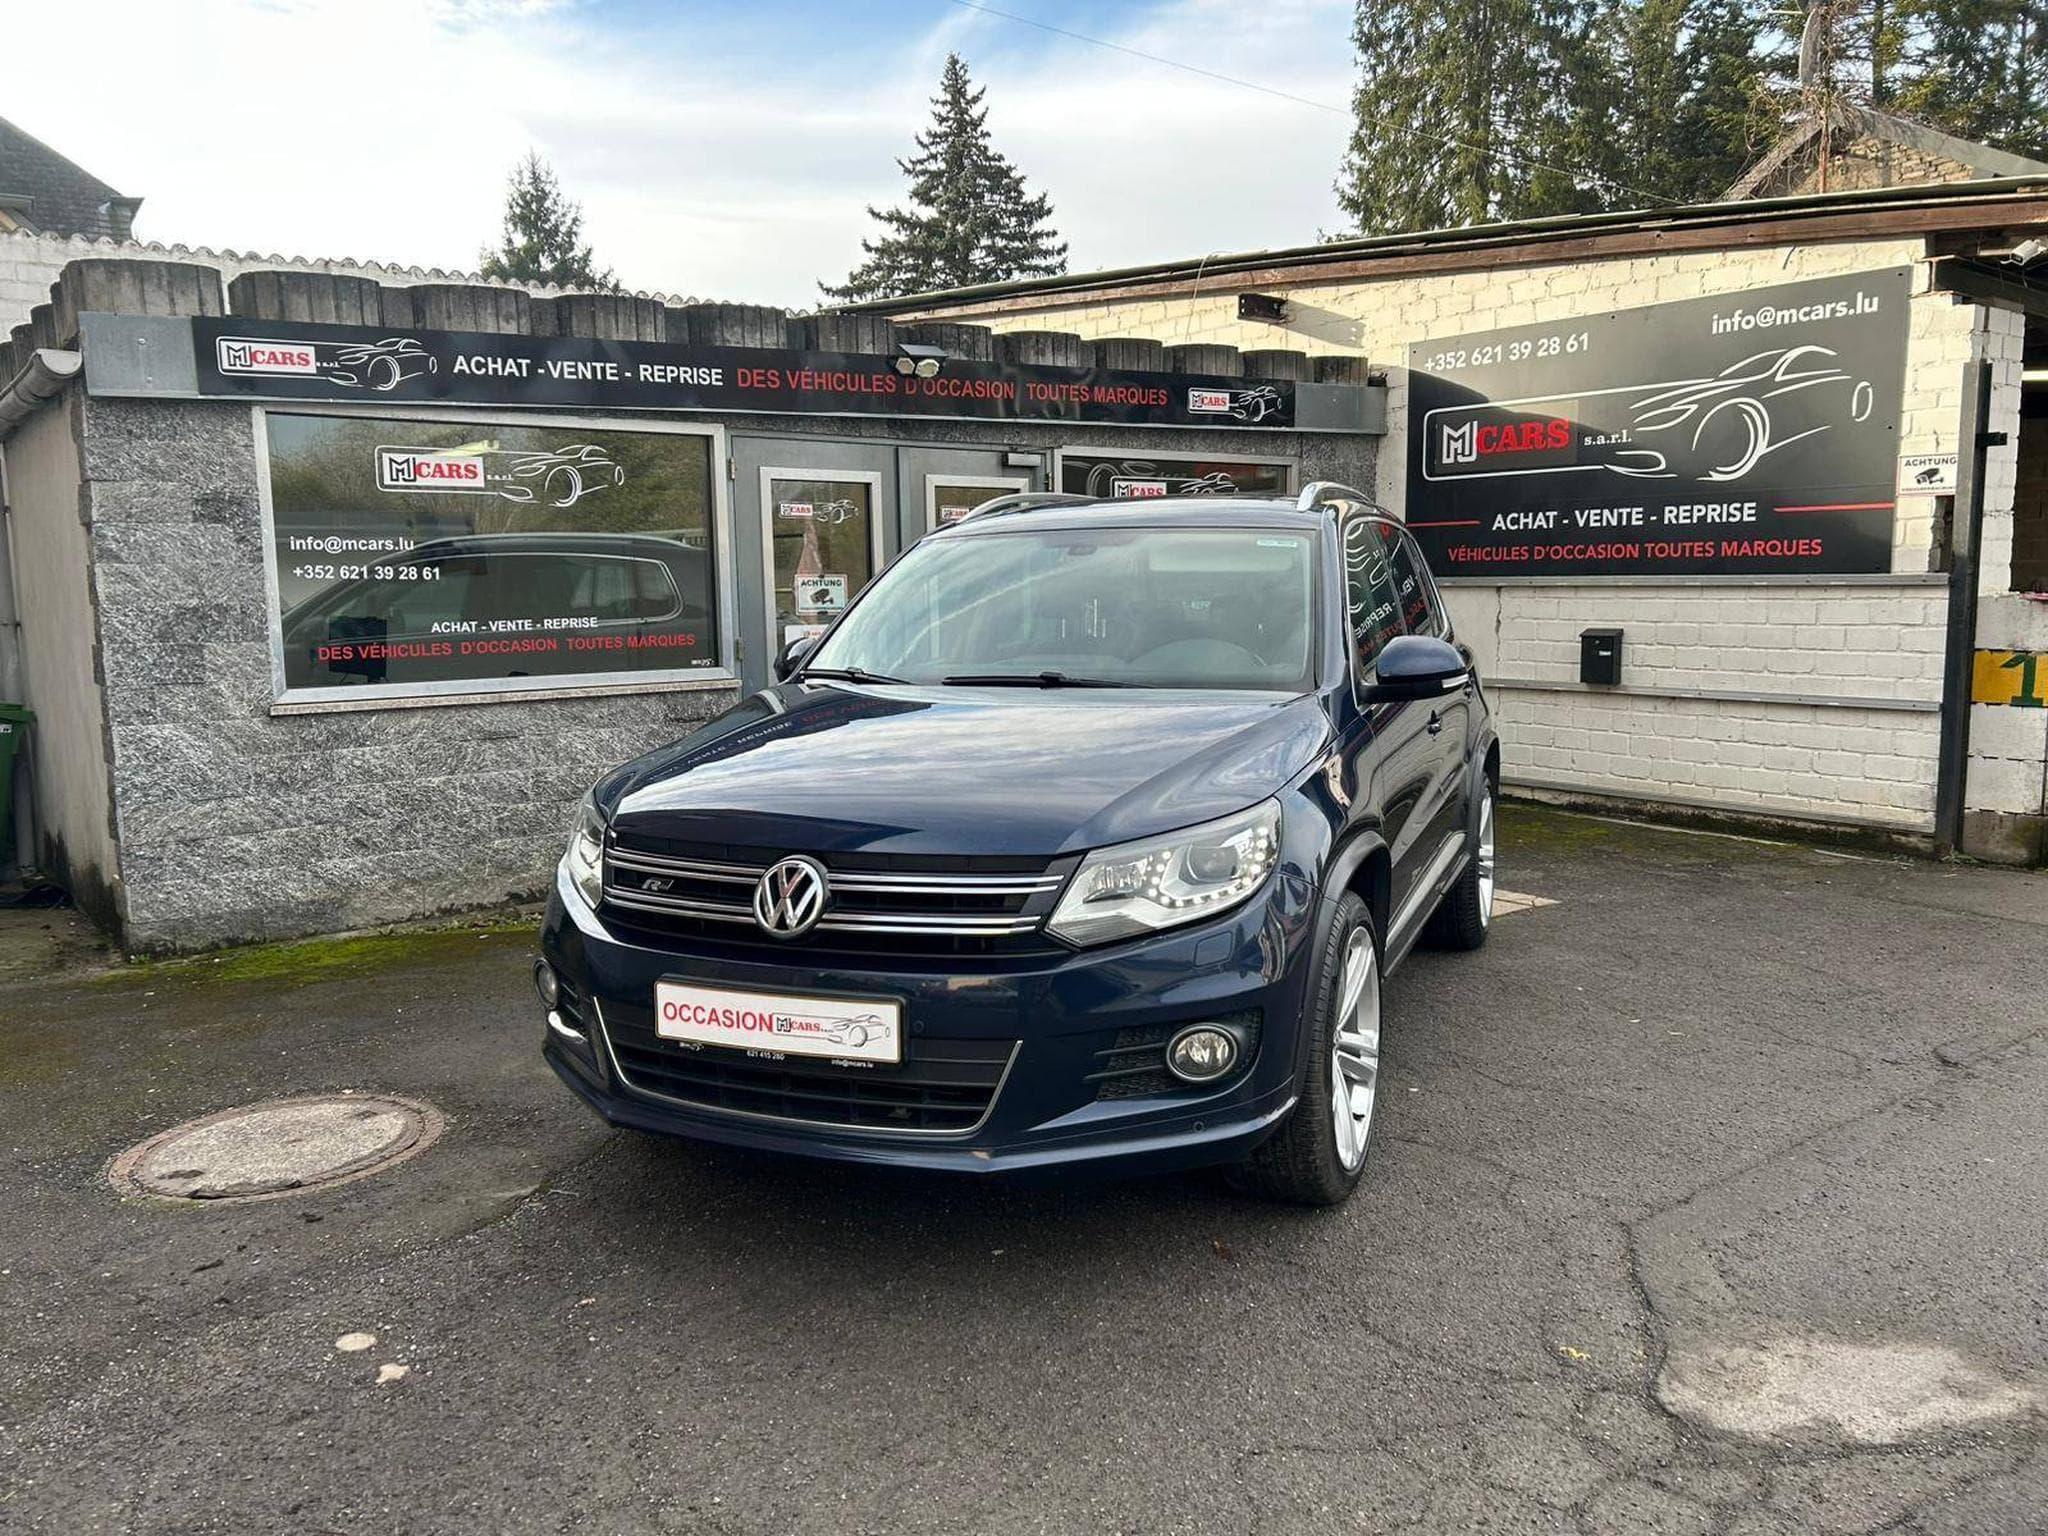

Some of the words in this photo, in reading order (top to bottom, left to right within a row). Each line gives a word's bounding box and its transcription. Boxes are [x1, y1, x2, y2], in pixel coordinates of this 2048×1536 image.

[1711, 292, 1879, 335] info@mcars.lu
[1424, 349, 1466, 373] +352
[1470, 346, 1502, 368] 621
[1508, 342, 1532, 361] 39
[1537, 339, 1561, 357] 28
[1567, 332, 1590, 353] 61
[453, 355, 531, 377] ACHAT
[639, 364, 723, 386] REPRISE
[737, 368, 780, 388] DES
[786, 366, 897, 394] VÉHICULES
[905, 375, 1015, 400] D'OCCASION
[1026, 383, 1089, 402] TOUTES
[1094, 386, 1168, 406] MARQUES
[1904, 456, 1957, 467] ACHTUNG
[1492, 512, 1557, 531] ACHAT
[1574, 507, 1643, 528] VENTE
[1663, 502, 1757, 525] REPRISE
[289, 536, 415, 554] info@mcars.lu
[1448, 543, 1529, 563] VÉHICULES
[1644, 541, 1715, 559] TOUTES
[1720, 538, 1823, 558] MARQUES
[293, 565, 335, 580] +352
[339, 565, 368, 580] 621
[374, 565, 394, 580] 39
[398, 566, 418, 580] 28
[422, 566, 441, 580] 61
[800, 579, 843, 587] ACHTUNG
[431, 621, 478, 633] ACHAT
[488, 619, 532, 632] VENTE
[544, 617, 599, 629] REPRISE
[318, 647, 353, 661] DES
[357, 642, 452, 660] VÉHICULES
[460, 638, 558, 655] D'OCCASION
[566, 636, 623, 650] TOUTES
[627, 633, 696, 648] MARQUES
[663, 1001, 773, 1032] OCCASION
